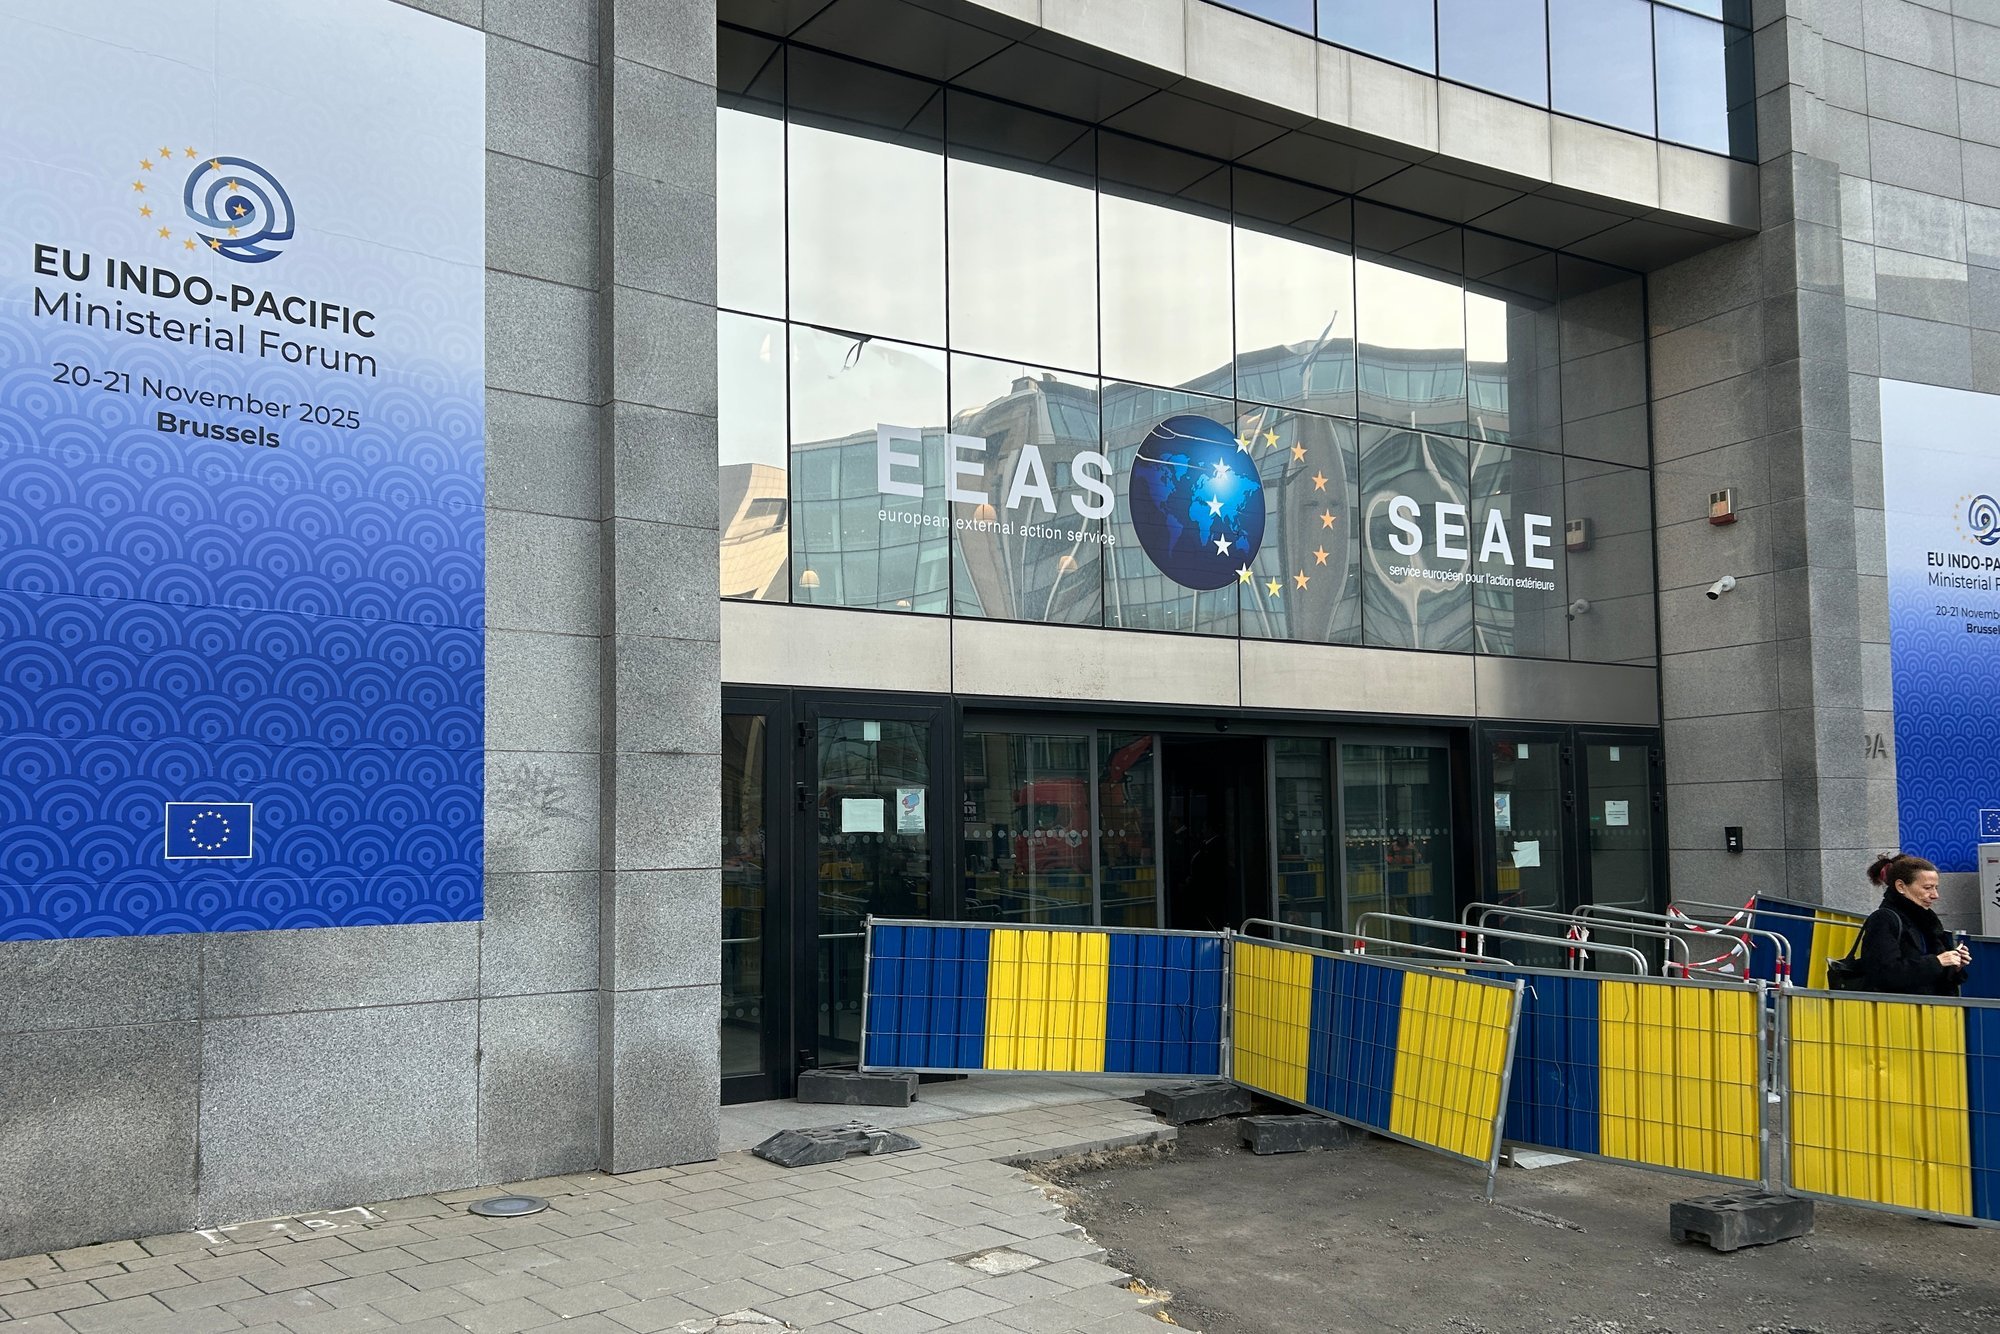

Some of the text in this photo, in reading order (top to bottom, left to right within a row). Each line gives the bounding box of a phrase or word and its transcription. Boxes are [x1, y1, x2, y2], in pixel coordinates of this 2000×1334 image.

[34, 243, 376, 338] EU INDO-PACIFIC
[34, 287, 377, 378] Ministerial Forum
[52, 362, 361, 430] 20-21 November 2025
[157, 411, 280, 448] Brussels
[877, 423, 1115, 519] EEAS
[878, 509, 1116, 545] european external action service
[1388, 495, 1554, 570] SEAE
[1389, 565, 1555, 591] service européen pour l'action extérieure
[1927, 552, 1944, 567] EU
[1928, 571, 1991, 591] Ministerial
[1936, 605, 2000, 620] 20-21 Novemb
